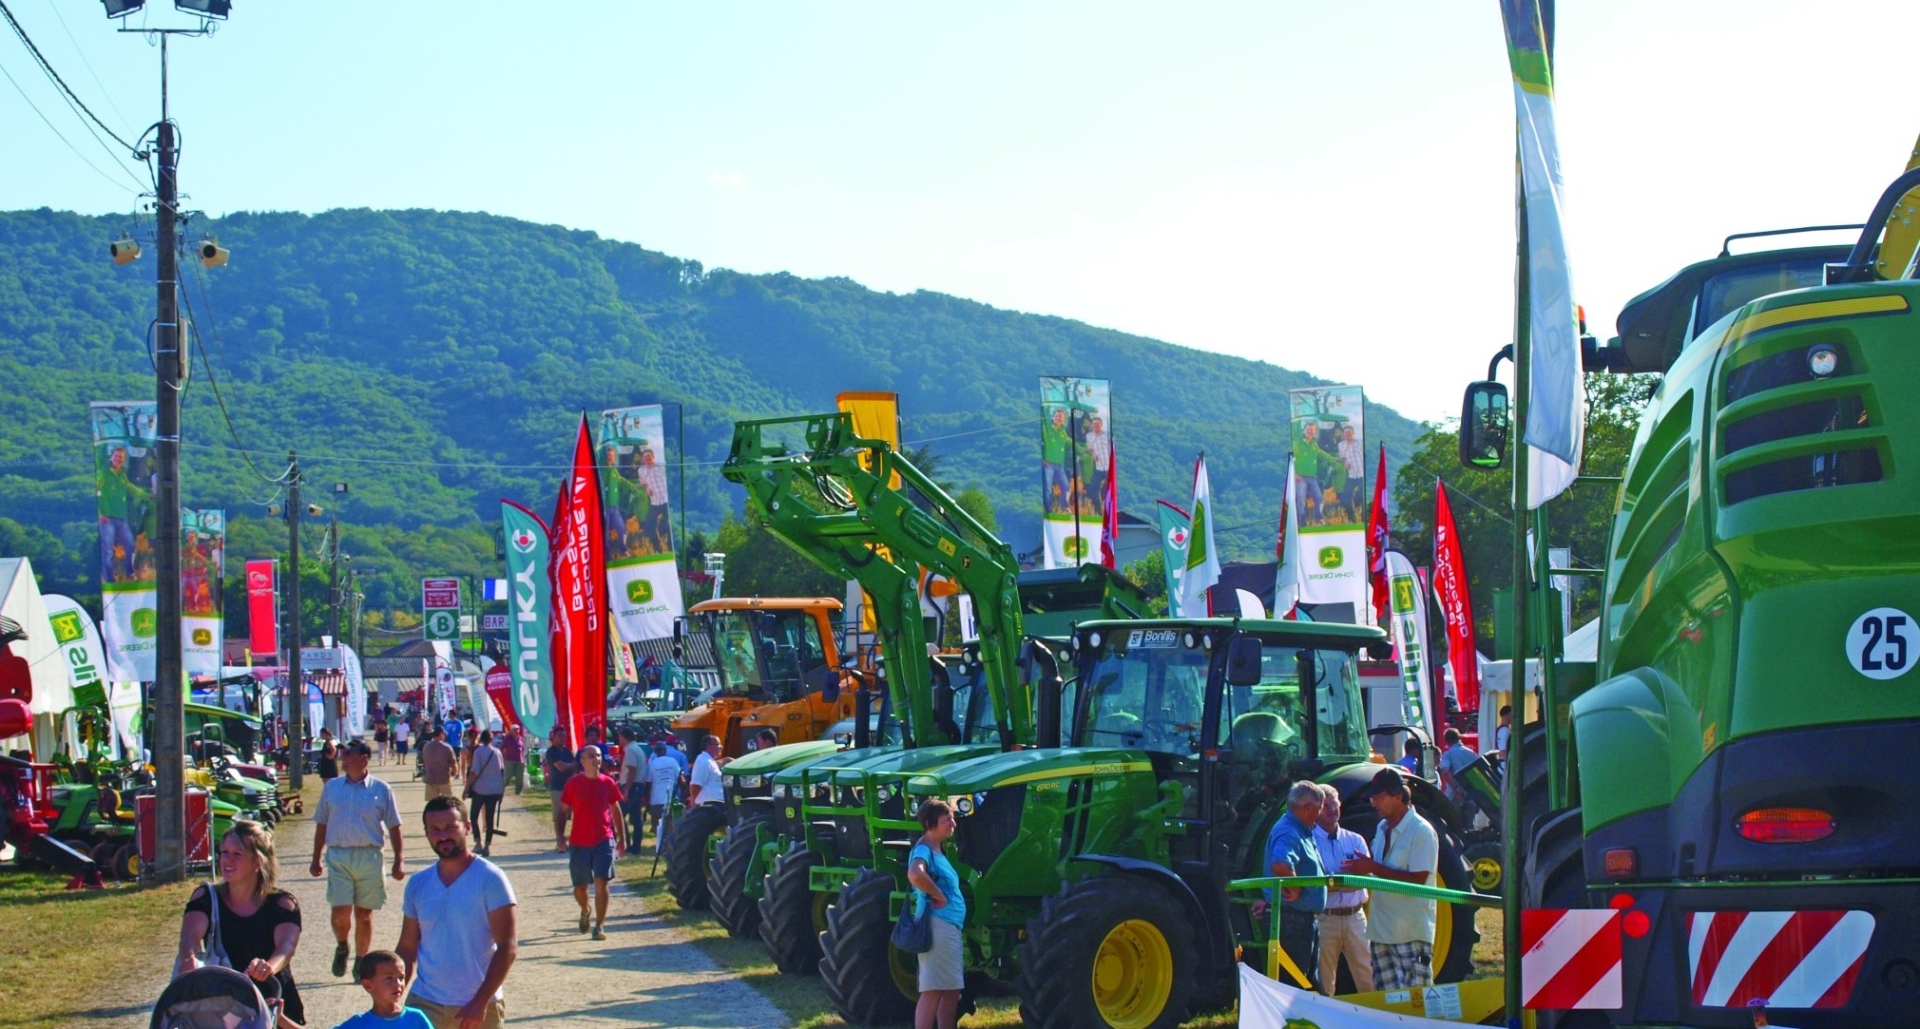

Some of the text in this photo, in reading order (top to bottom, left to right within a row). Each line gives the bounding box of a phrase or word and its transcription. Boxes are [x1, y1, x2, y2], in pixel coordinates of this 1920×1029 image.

[437, 616, 449, 632] B
[485, 616, 504, 628] BAR
[1145, 631, 1176, 641] Bonfils
[1862, 616, 1907, 671] 25
